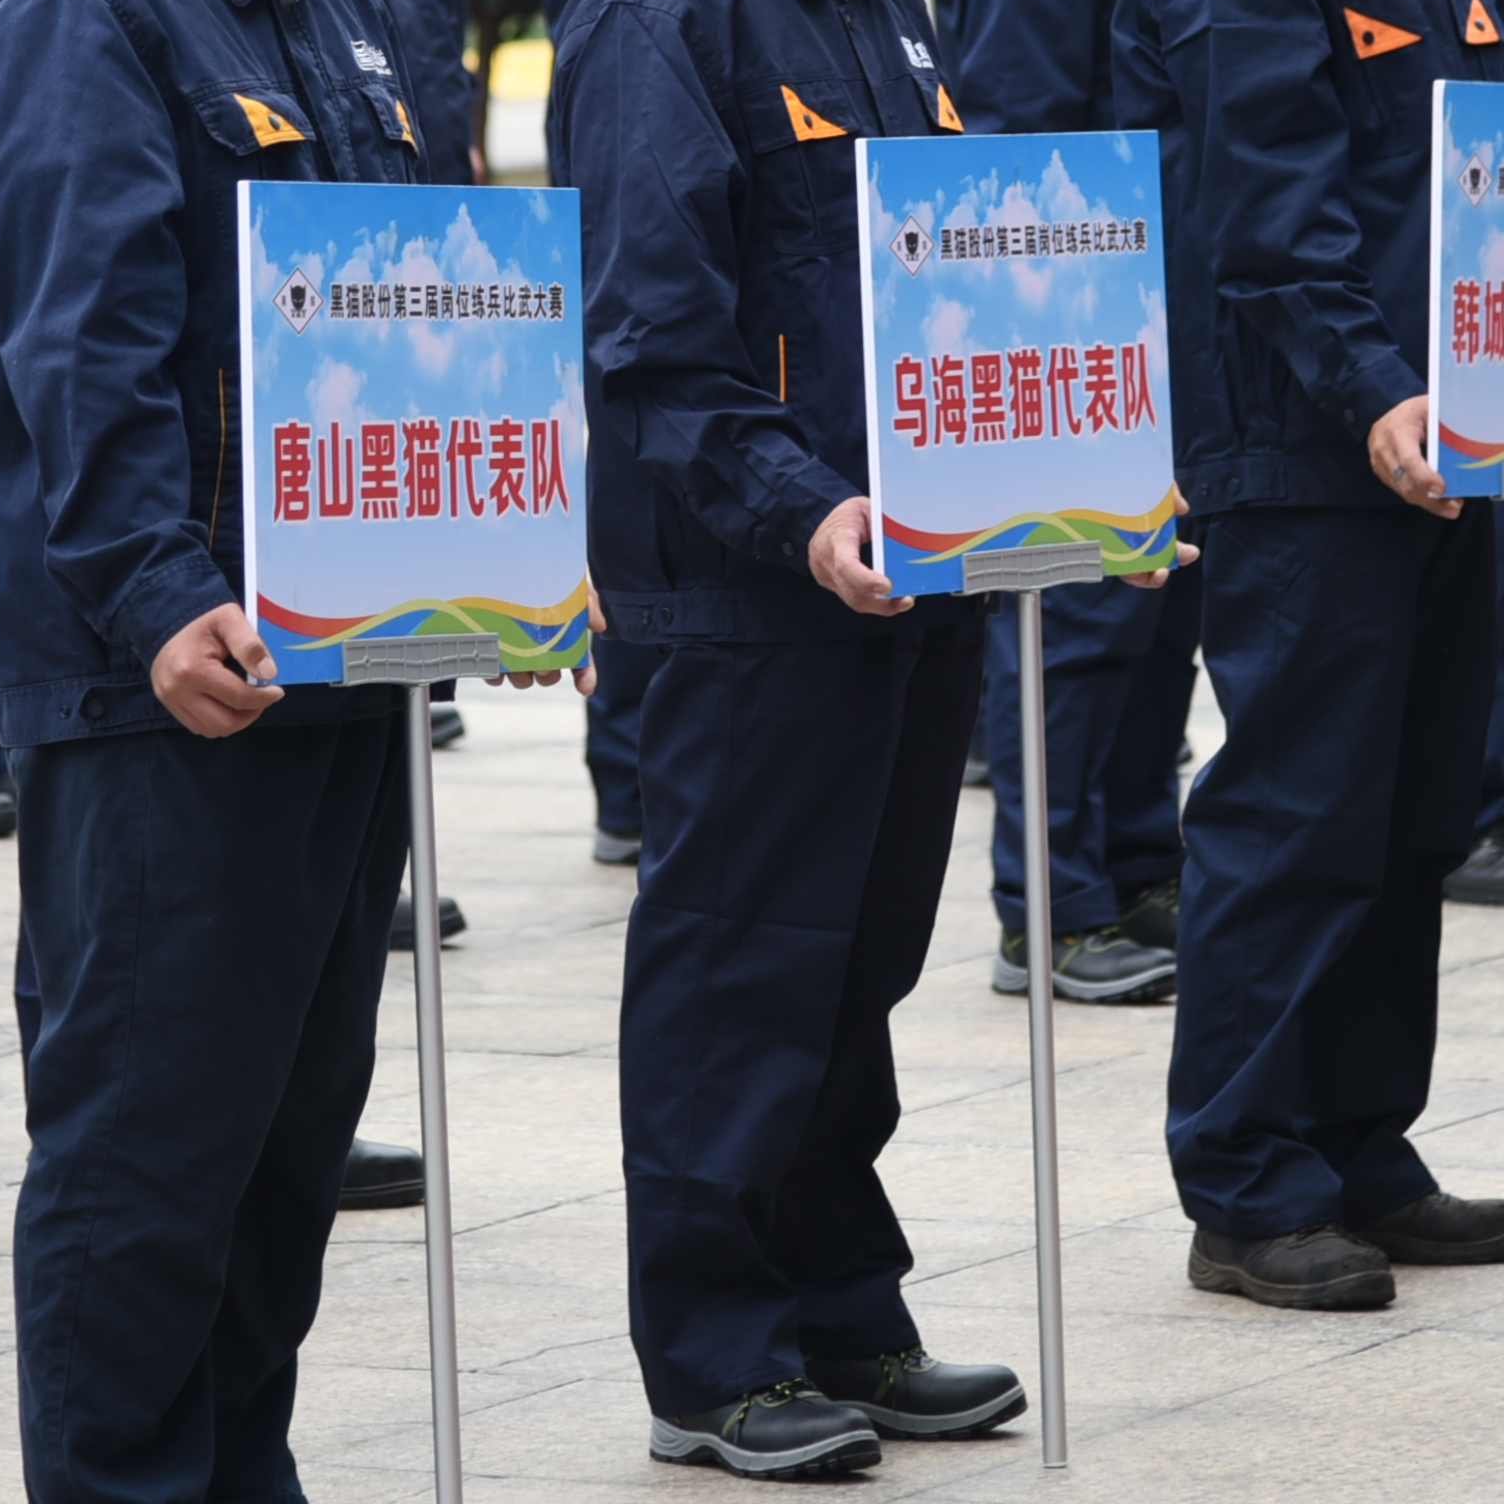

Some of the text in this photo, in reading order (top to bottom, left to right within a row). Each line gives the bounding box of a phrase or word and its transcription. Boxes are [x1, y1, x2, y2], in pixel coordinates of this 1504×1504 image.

[940, 218, 1147, 260] 黑猫股份第三届岗位练兵比武大赛
[329, 282, 564, 320] 黑猫股份第三届岗位练兵比武大赛
[893, 343, 1157, 447] 乌海黑猫代表队
[273, 418, 570, 525] 唐山黑猫代表队
